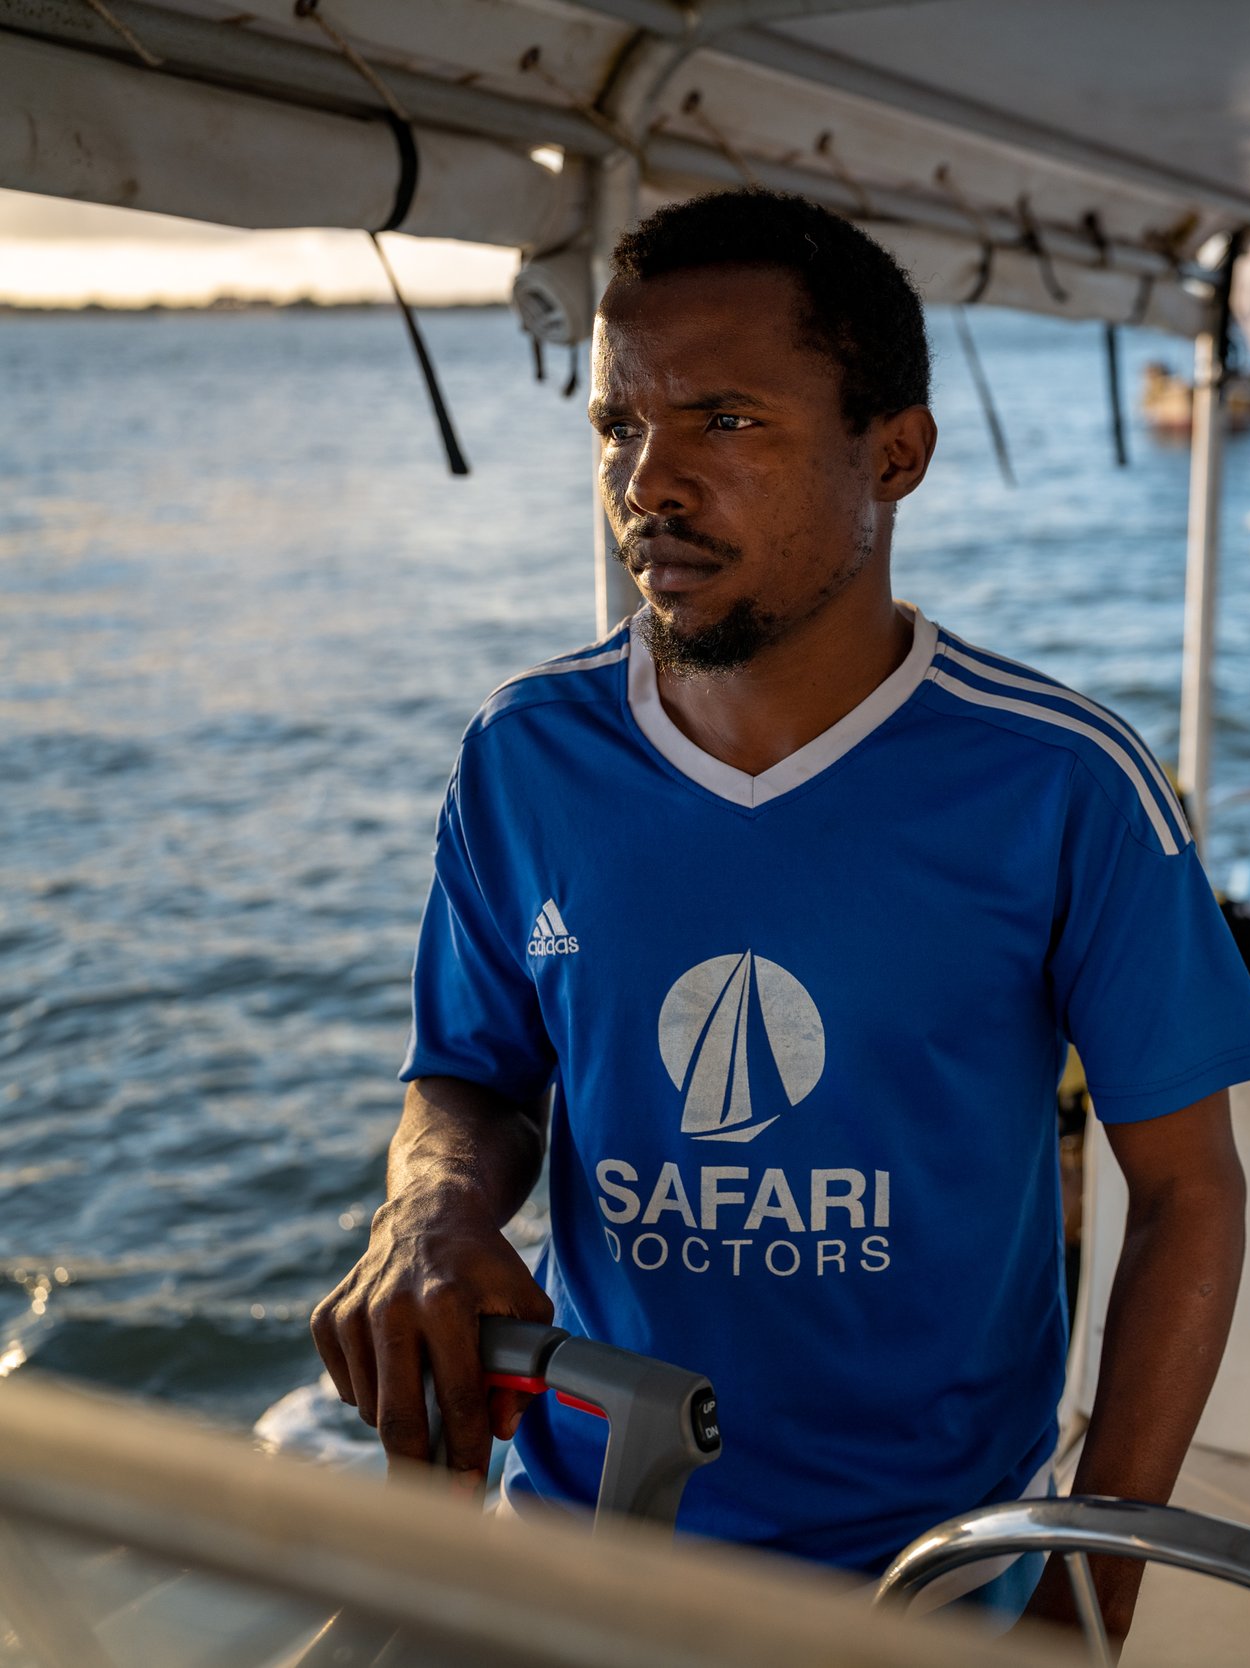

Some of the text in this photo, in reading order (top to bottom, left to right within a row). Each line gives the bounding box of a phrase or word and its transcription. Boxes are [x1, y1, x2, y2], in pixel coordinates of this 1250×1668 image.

[528, 935, 580, 957] adidas
[595, 1159, 890, 1232] SAFARI
[604, 1226, 891, 1277] DOCTORS
[703, 1401, 716, 1414] UP
[705, 1425, 719, 1439] DN
